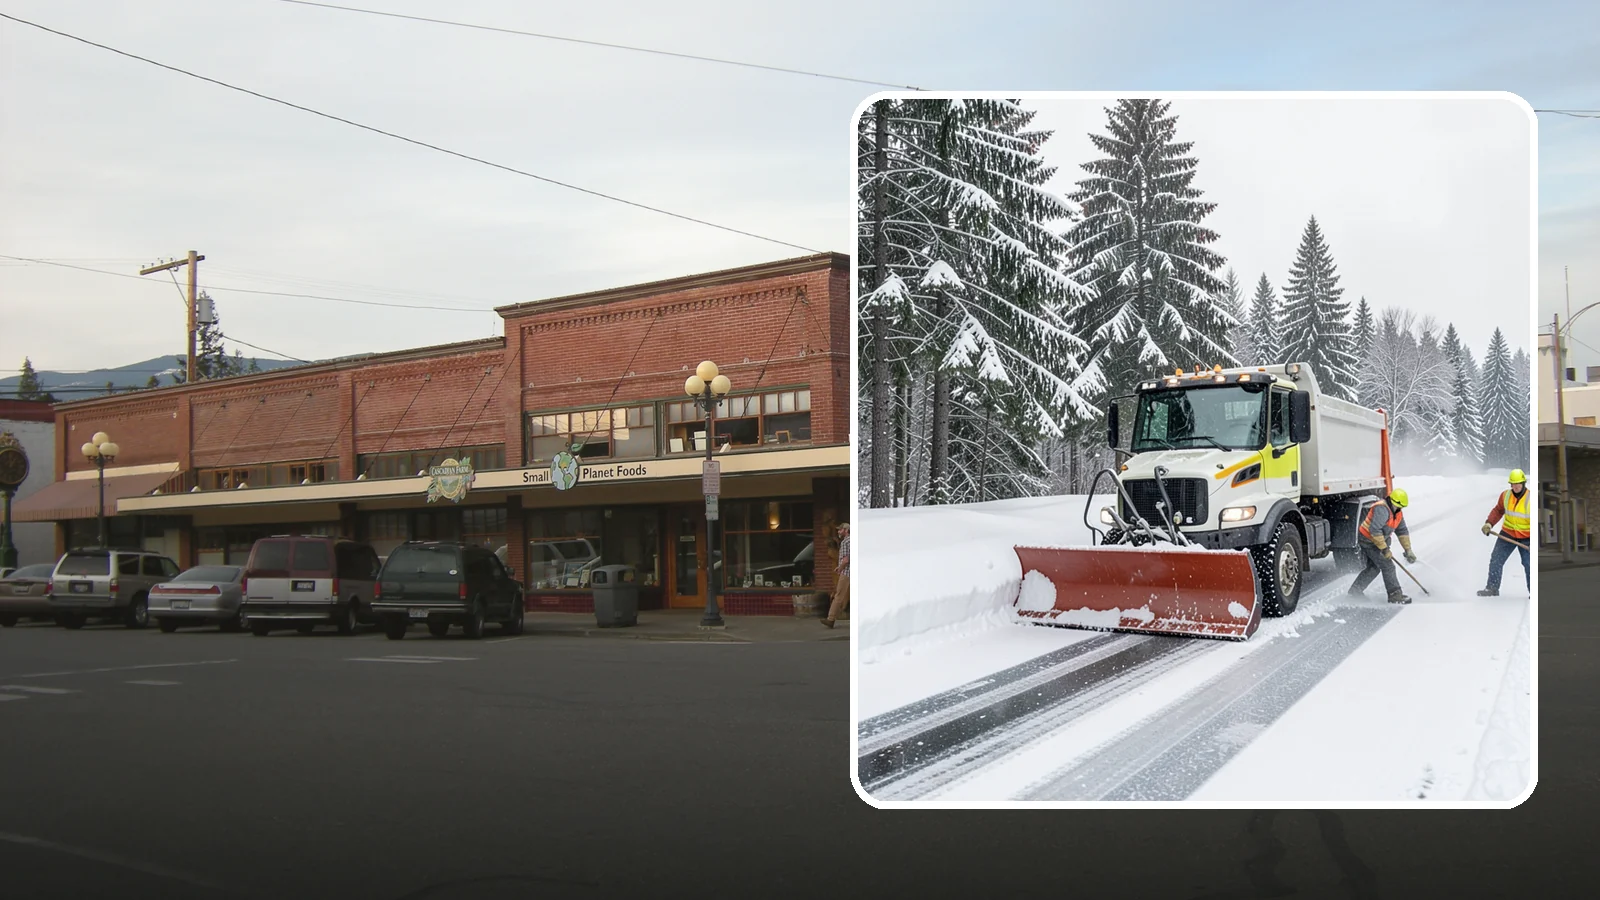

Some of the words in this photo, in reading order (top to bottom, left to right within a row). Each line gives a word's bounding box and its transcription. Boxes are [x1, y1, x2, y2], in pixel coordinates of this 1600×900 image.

[523, 471, 549, 482] Small
[582, 467, 614, 479] Planet
[617, 464, 647, 476] Foods
